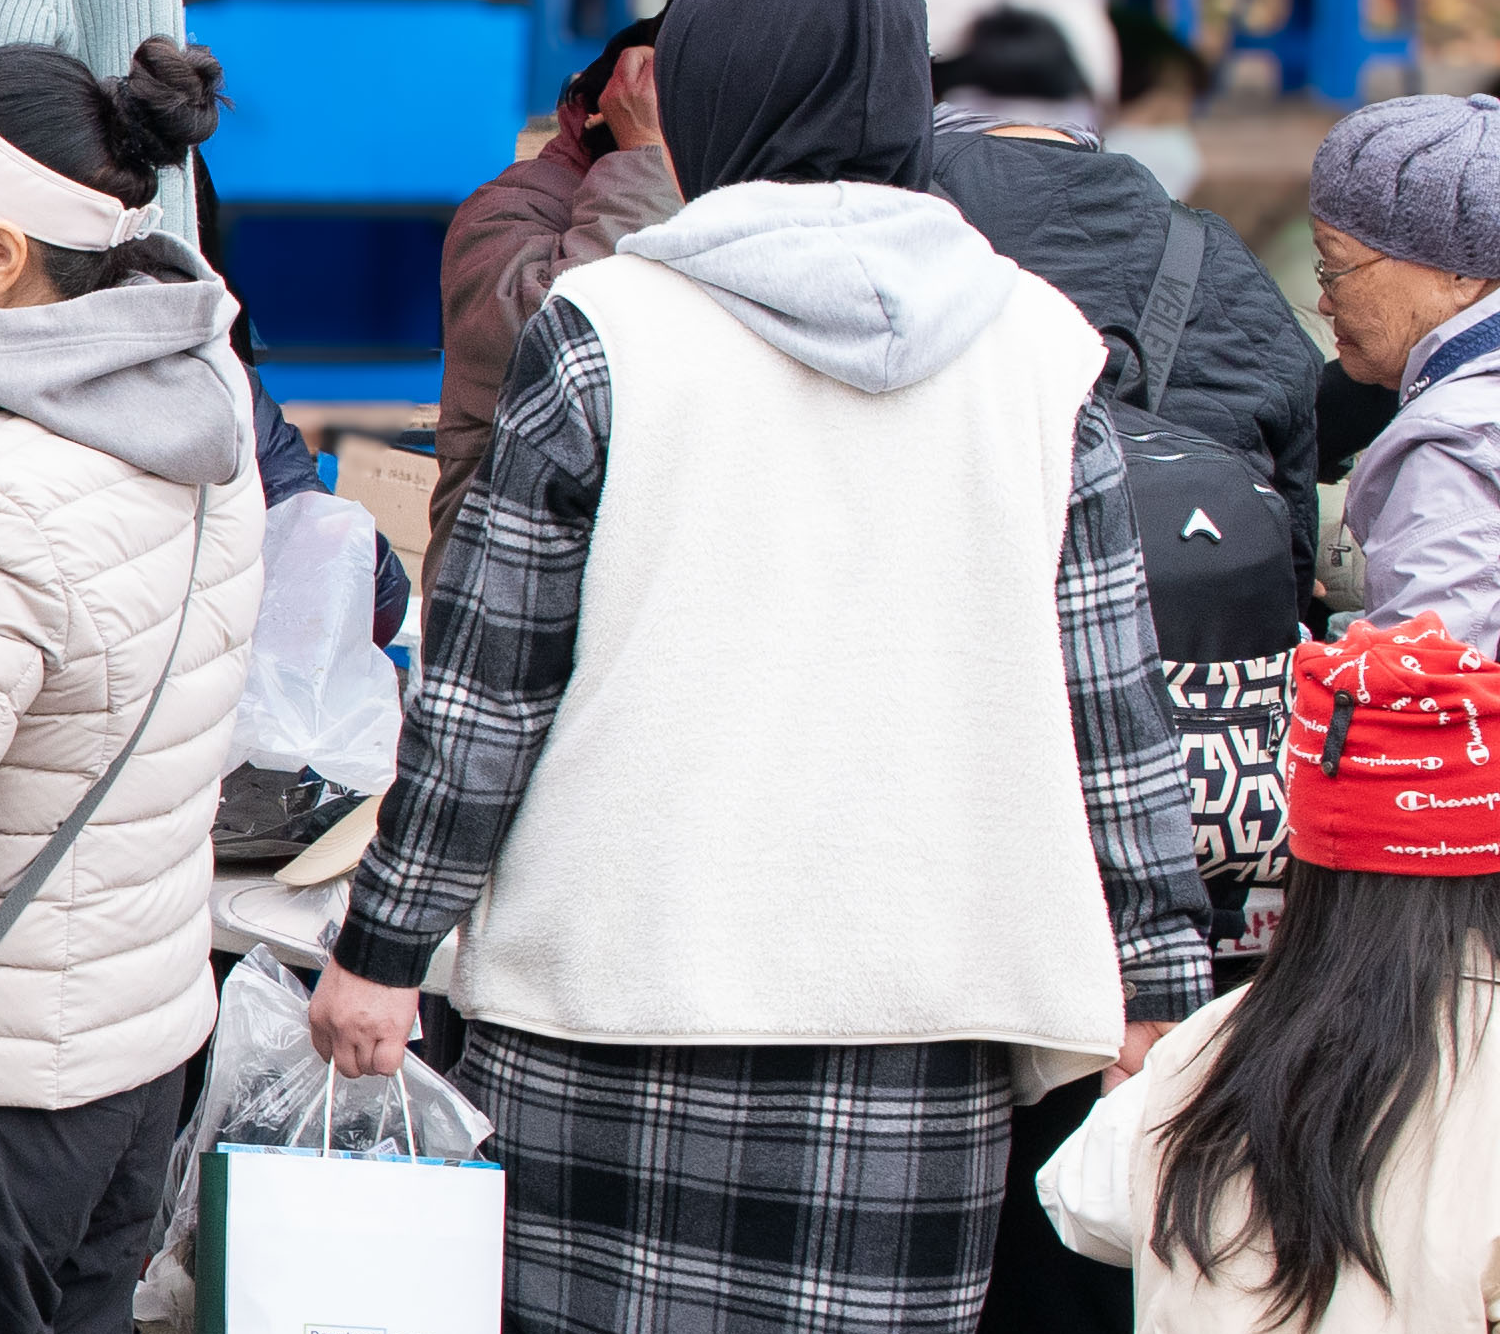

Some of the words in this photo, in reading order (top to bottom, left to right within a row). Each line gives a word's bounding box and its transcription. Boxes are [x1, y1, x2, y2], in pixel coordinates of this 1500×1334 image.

[1351, 756, 1444, 770] Champion
[1396, 790, 1500, 811] Champ
[1383, 841, 1500, 858] hampion
